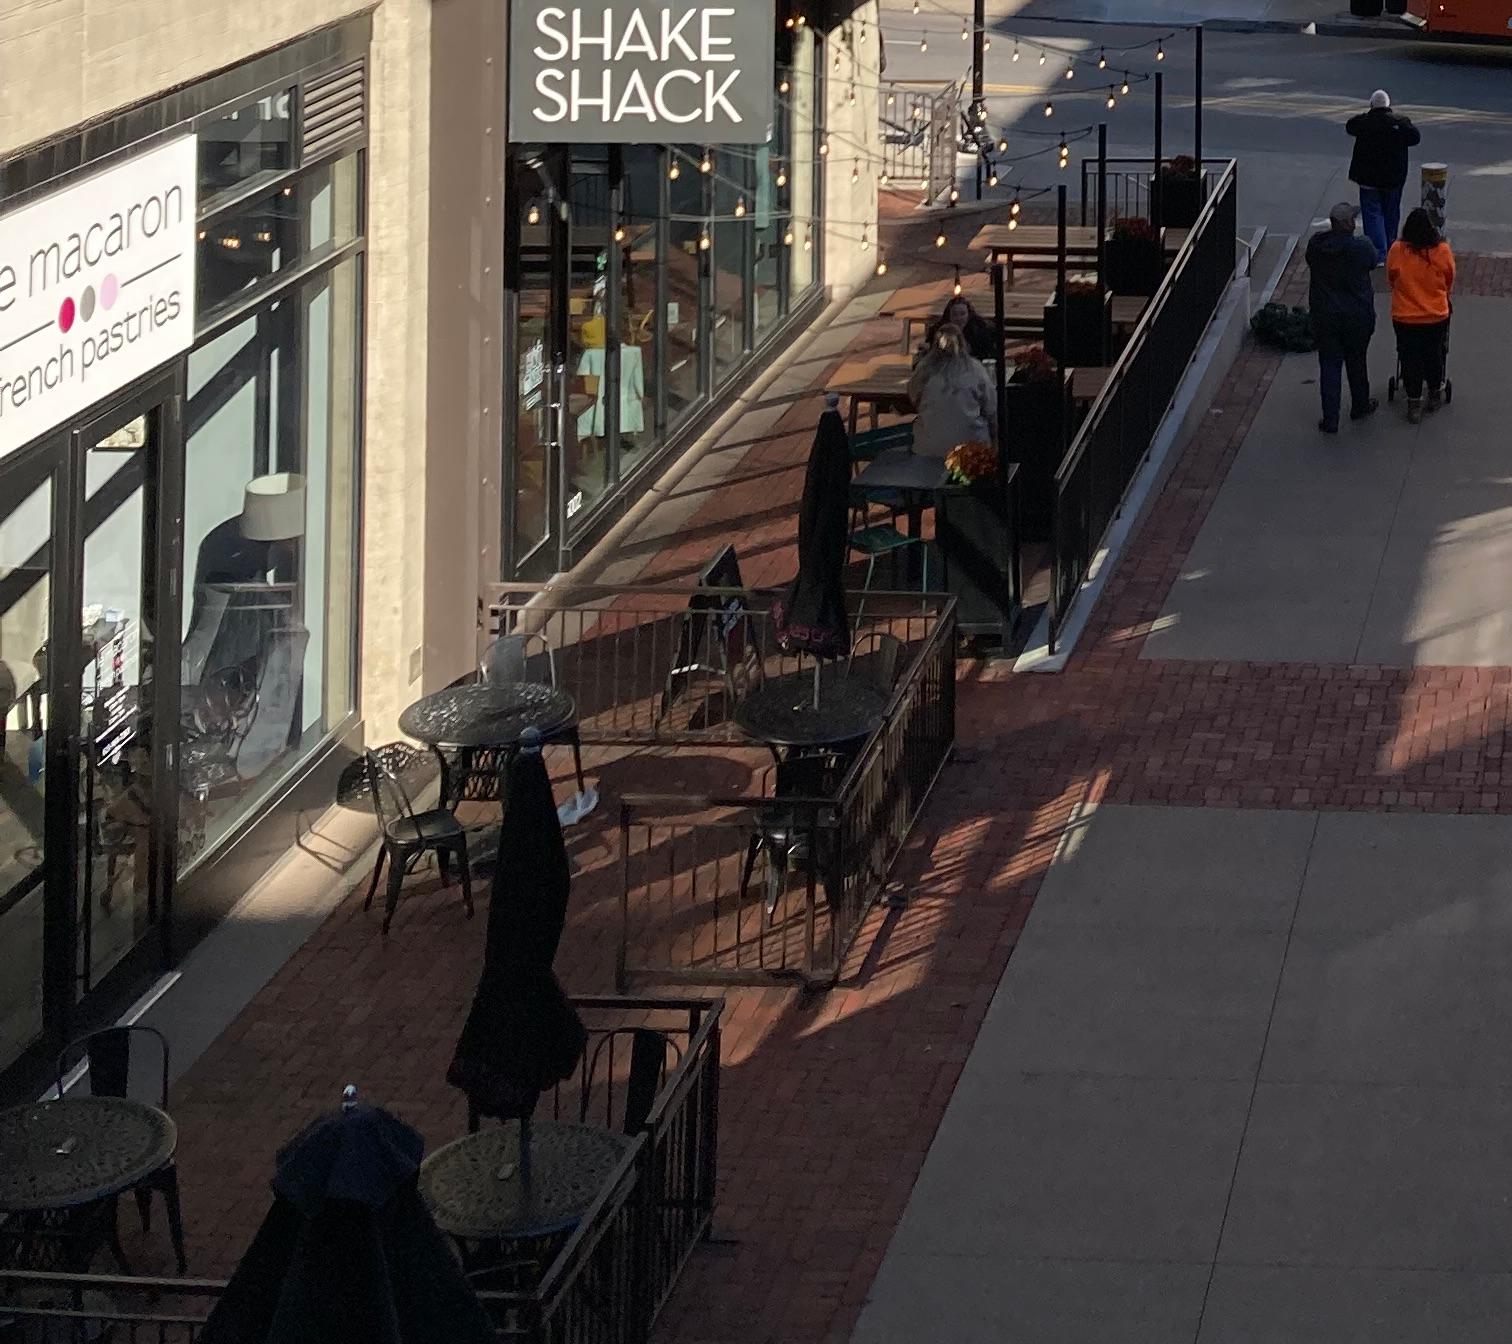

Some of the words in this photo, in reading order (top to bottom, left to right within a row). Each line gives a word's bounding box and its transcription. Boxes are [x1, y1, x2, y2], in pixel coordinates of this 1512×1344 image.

[533, 7, 736, 62] SHAKE
[532, 68, 743, 124] SHACK
[0, 261, 17, 313] e
[28, 184, 183, 299] macaron
[0, 342, 75, 418] rench
[80, 289, 182, 385] pastries
